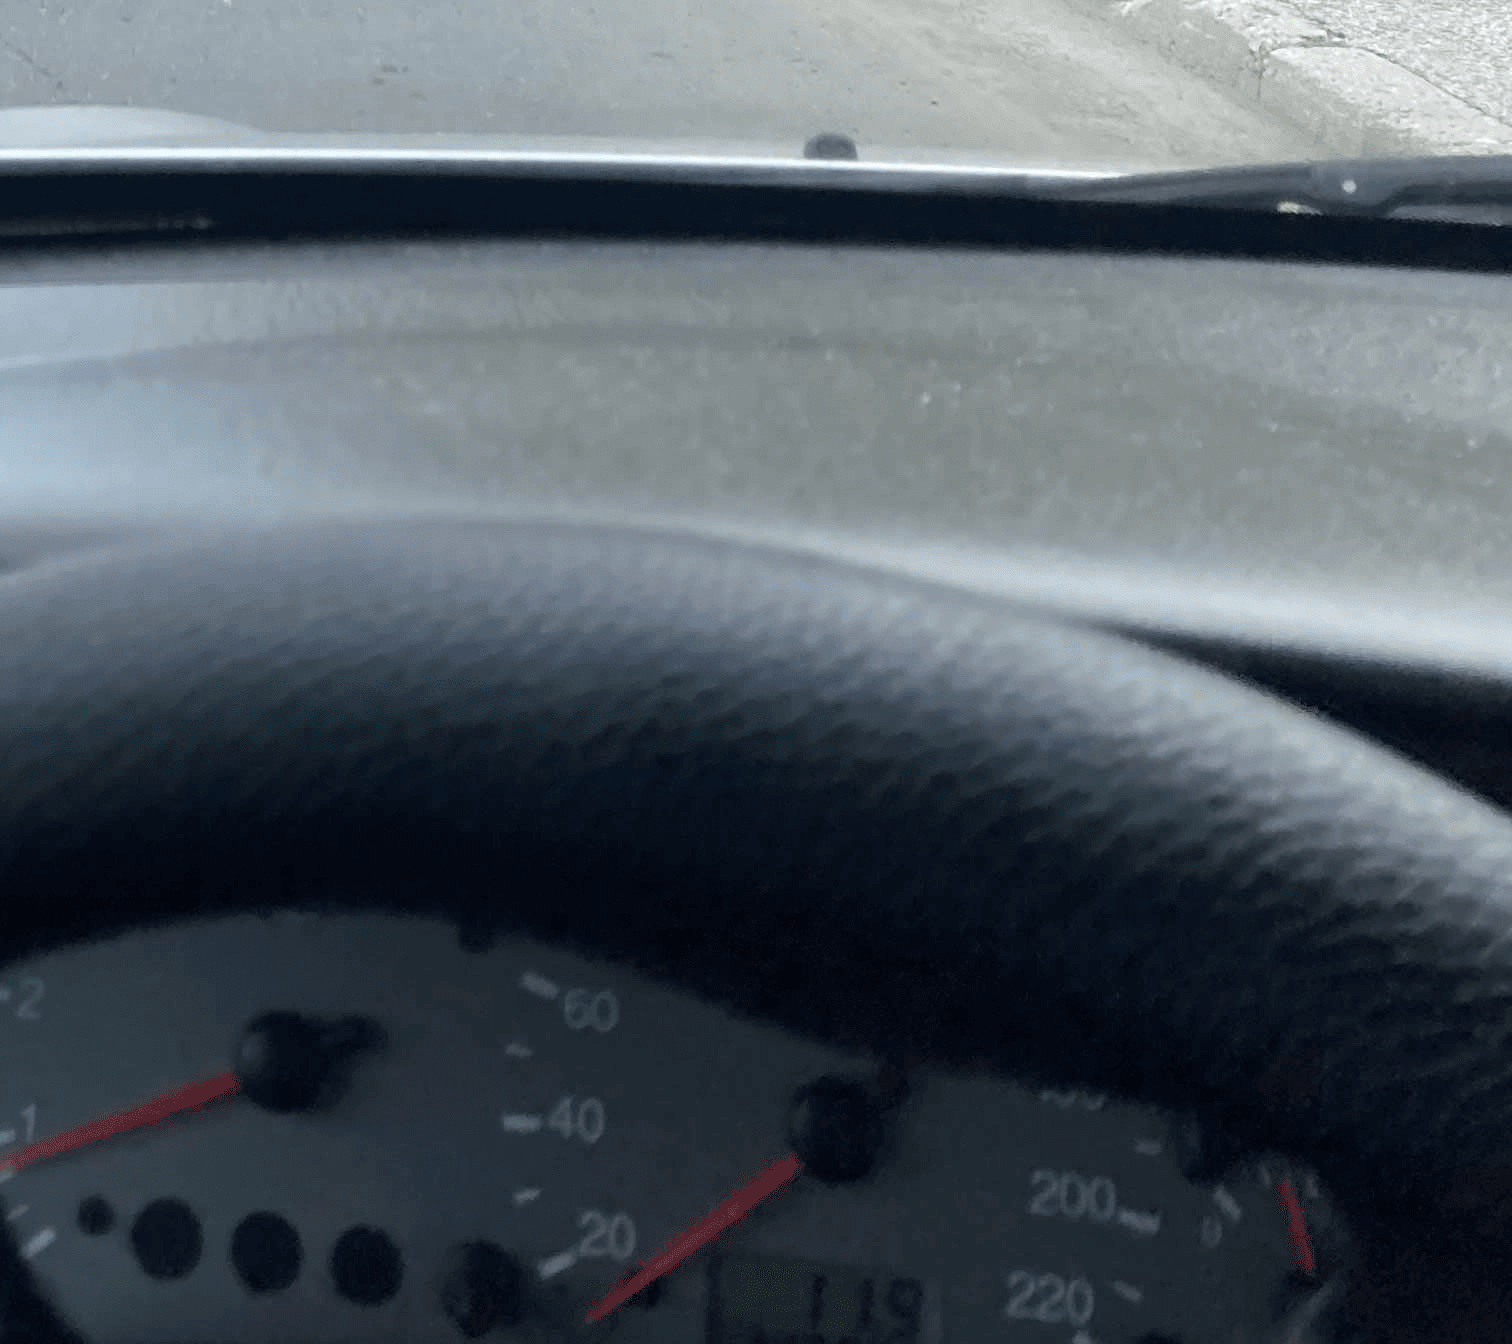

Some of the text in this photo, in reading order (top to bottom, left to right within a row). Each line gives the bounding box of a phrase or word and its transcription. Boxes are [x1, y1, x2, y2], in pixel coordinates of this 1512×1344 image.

[17, 977, 46, 1020] 2
[563, 988, 620, 1033] 60
[20, 1103, 38, 1143] 1
[548, 1095, 606, 1144] 40
[1029, 1168, 1117, 1223] 200
[578, 1210, 637, 1260] 20
[1005, 1268, 1095, 1327] 220
